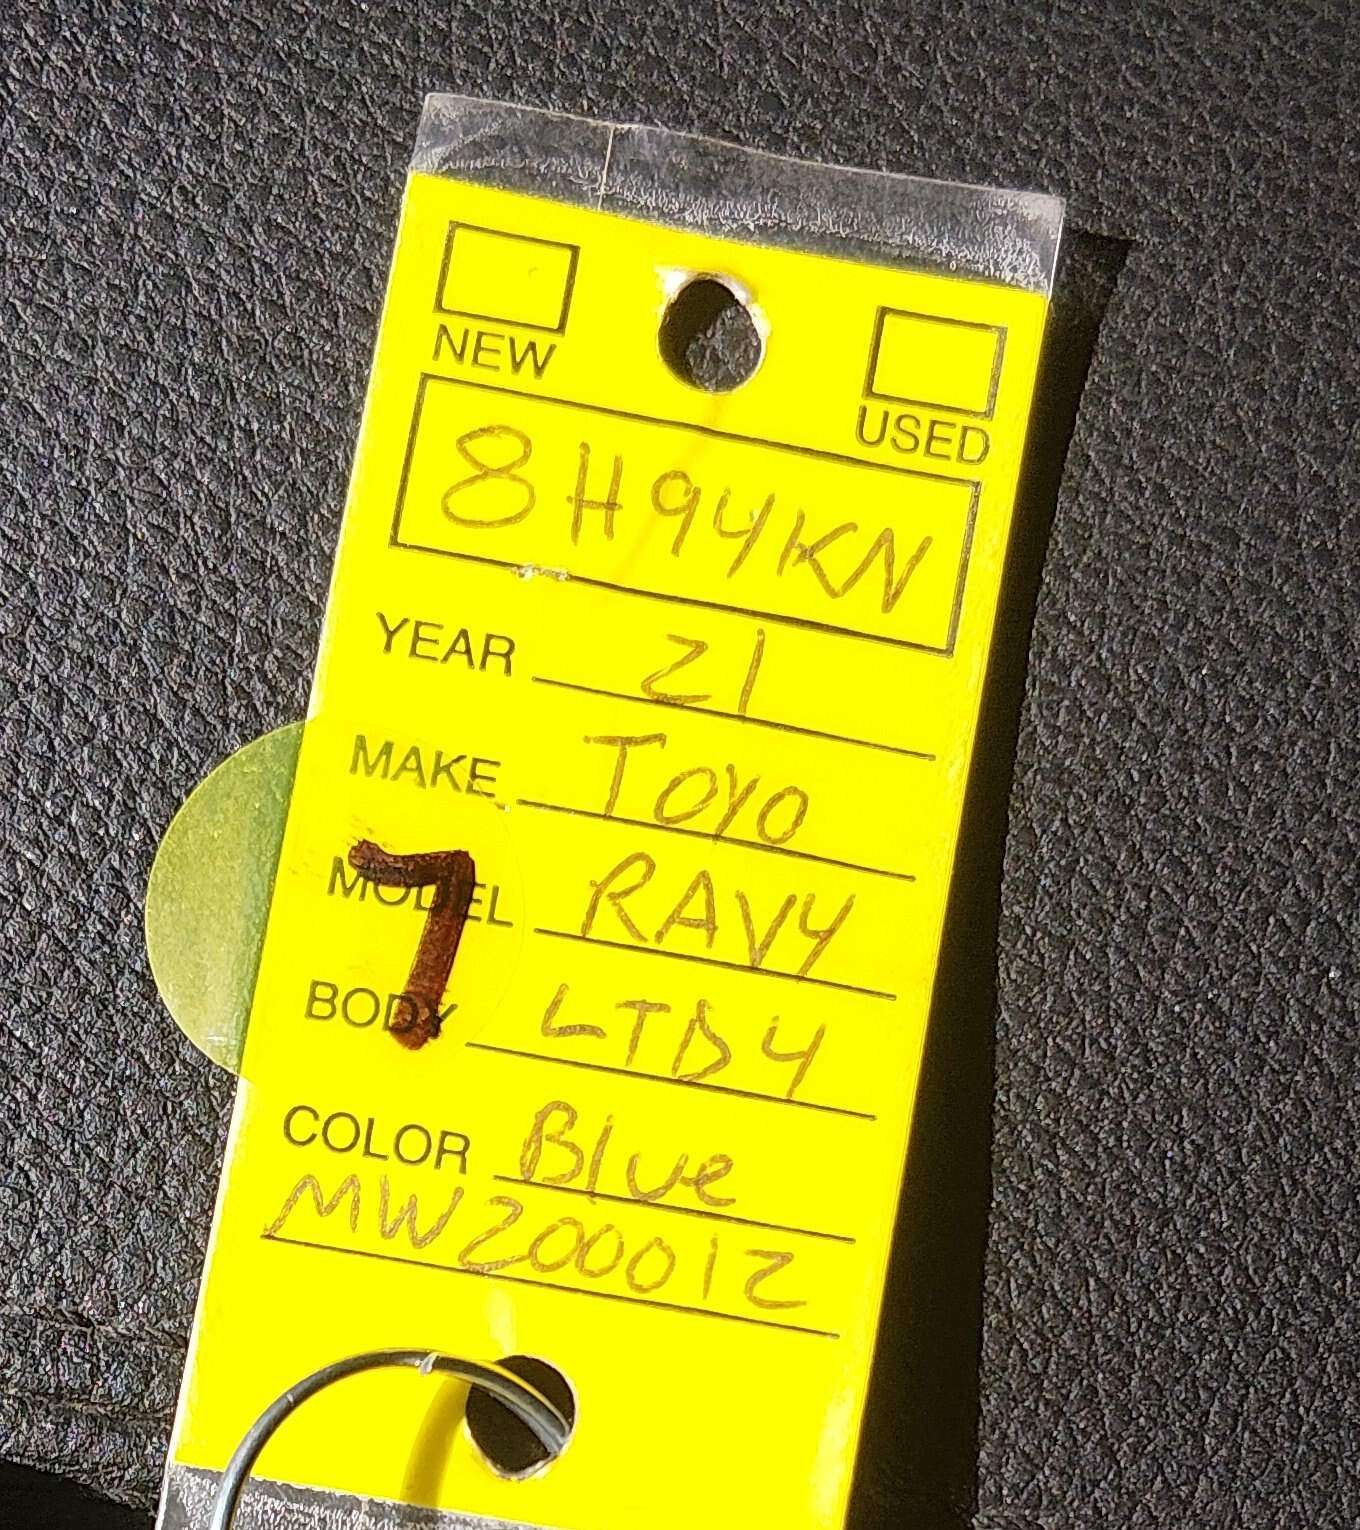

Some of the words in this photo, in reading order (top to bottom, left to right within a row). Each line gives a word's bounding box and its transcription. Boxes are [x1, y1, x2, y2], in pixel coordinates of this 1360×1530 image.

[432, 324, 557, 380] NEW
[855, 405, 990, 465] USED
[376, 612, 516, 676] YEAR
[640, 629, 764, 714] 21
[348, 734, 502, 799] MAKE
[348, 839, 475, 1050] 7
[304, 979, 459, 1039] BODY
[282, 1106, 470, 1174] COLOR
[520, 1101, 736, 1205] Blue
